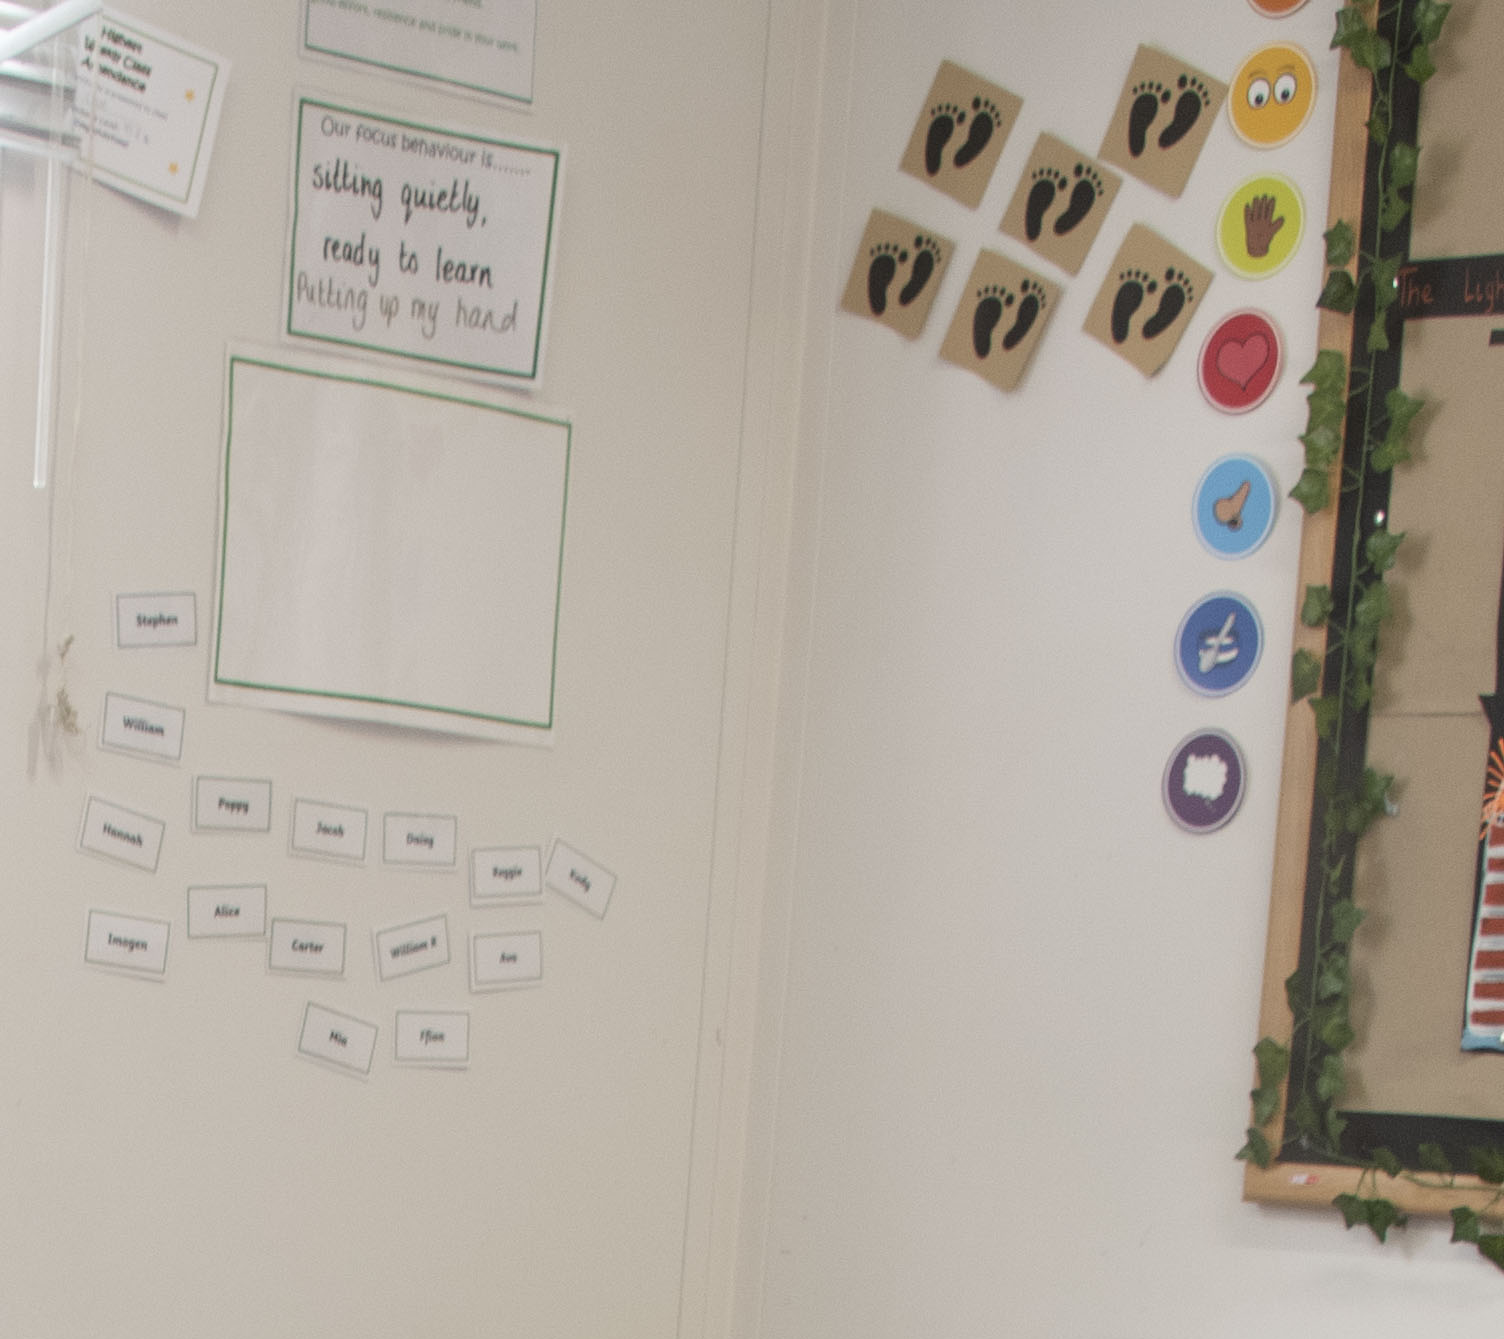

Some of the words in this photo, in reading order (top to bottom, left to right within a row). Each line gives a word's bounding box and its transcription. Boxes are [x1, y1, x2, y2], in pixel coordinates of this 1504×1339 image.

[321, 115, 352, 137] Our
[356, 123, 397, 149] focus
[401, 134, 476, 163] behaviour
[312, 157, 383, 221] sitting
[401, 177, 488, 229] quietly,
[323, 231, 380, 288] ready
[399, 241, 418, 274] to
[435, 246, 494, 288] learn
[1396, 266, 1434, 307] The
[297, 271, 368, 332] Putting
[379, 295, 399, 328] up
[411, 299, 439, 340] my
[456, 298, 519, 333] hand
[136, 612, 179, 630] Stephen
[123, 715, 165, 737] William
[103, 822, 143, 847] Hannah
[214, 906, 241, 919] Alice
[108, 933, 148, 952] Imogen
[292, 938, 324, 954] Carter
[329, 1029, 348, 1047] Mia
